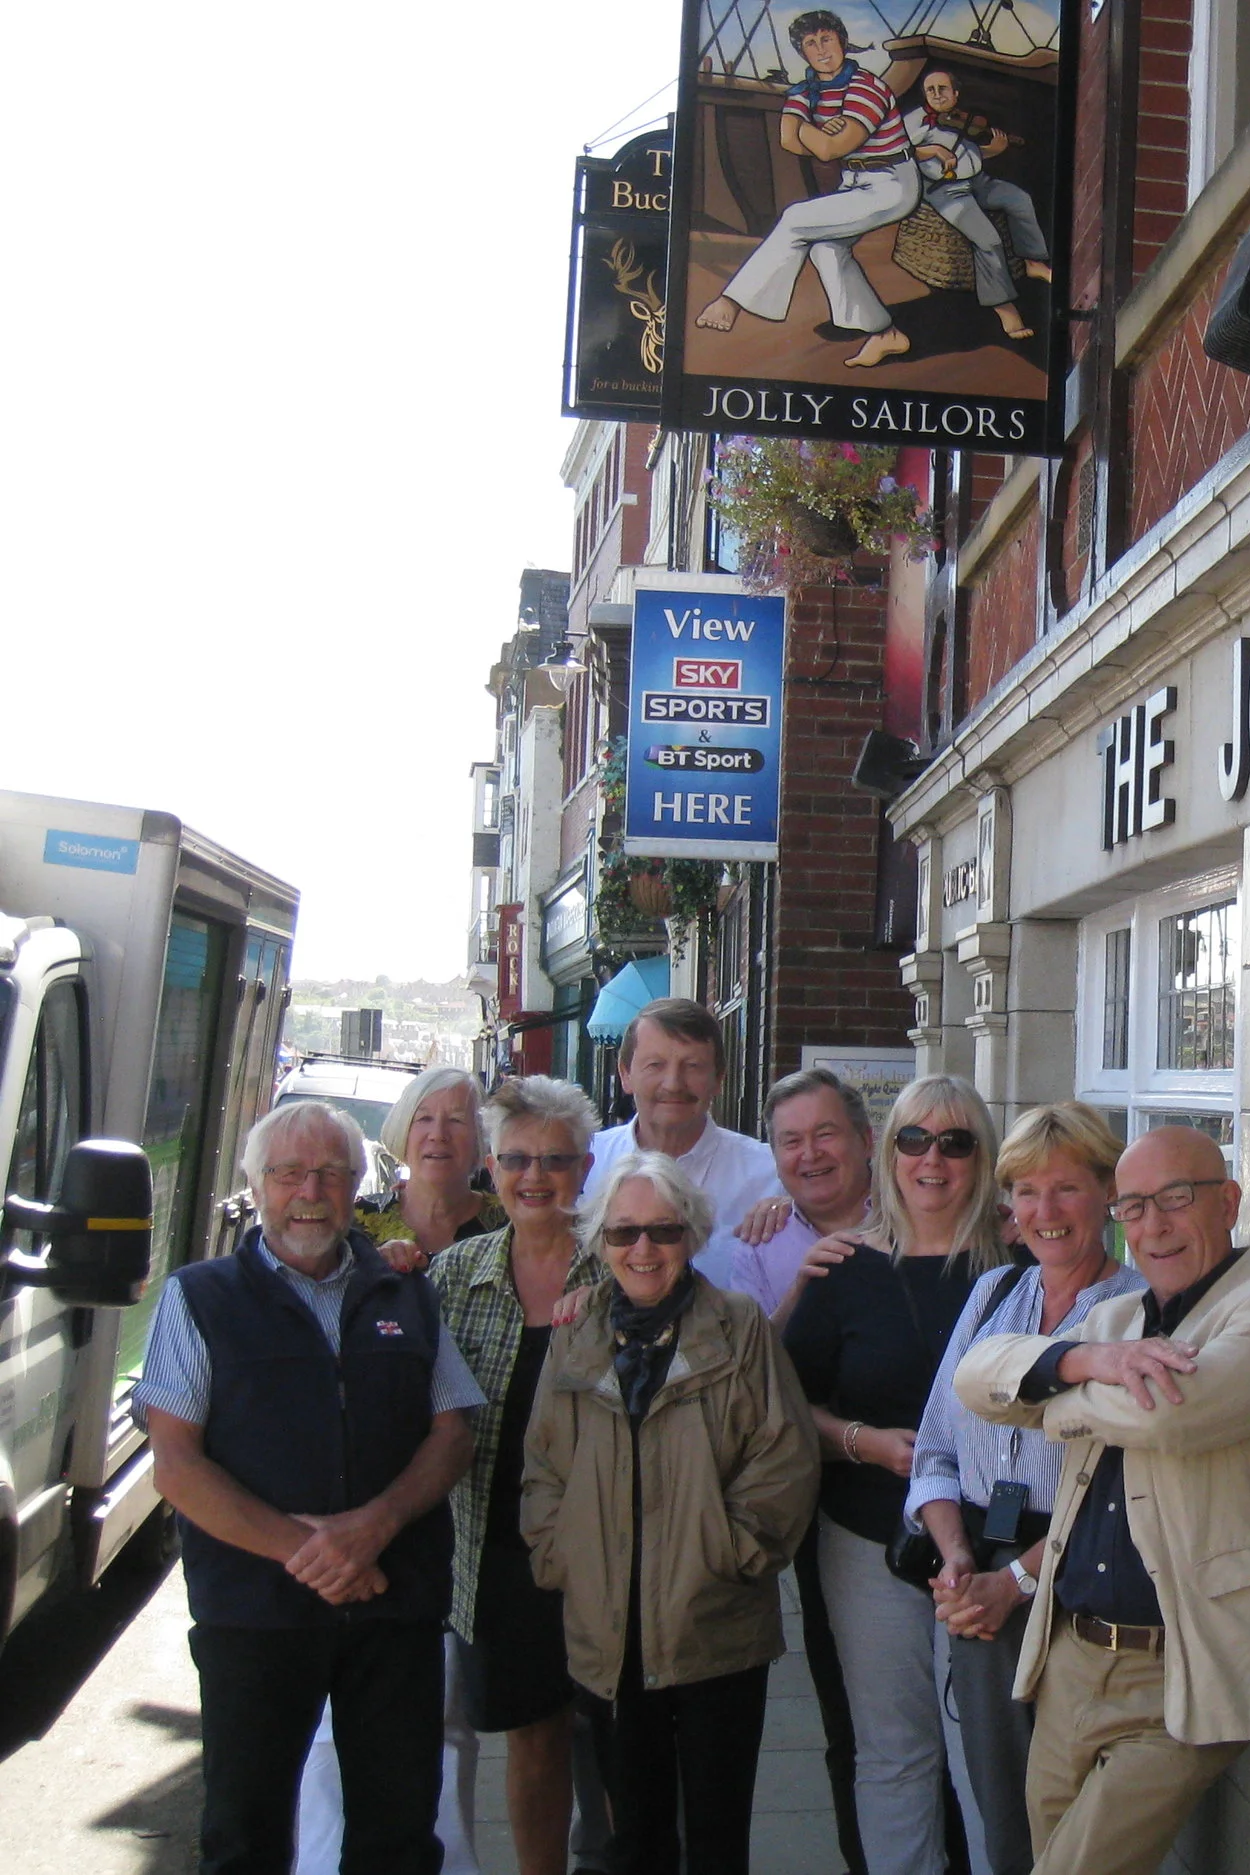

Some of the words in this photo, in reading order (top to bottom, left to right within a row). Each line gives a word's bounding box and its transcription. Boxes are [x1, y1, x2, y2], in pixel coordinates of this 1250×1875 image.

[611, 180, 671, 211] Buc
[621, 379, 662, 393] buckin
[702, 386, 834, 425] JOLLY
[851, 398, 1025, 440] SAILORS
[663, 608, 756, 642] View
[680, 664, 736, 686] SKY
[648, 698, 763, 722] SPORTS
[698, 729, 713, 743] &
[657, 750, 691, 766] BT
[694, 750, 751, 770] Sport
[1097, 686, 1178, 851] THE
[653, 791, 752, 825] HERE
